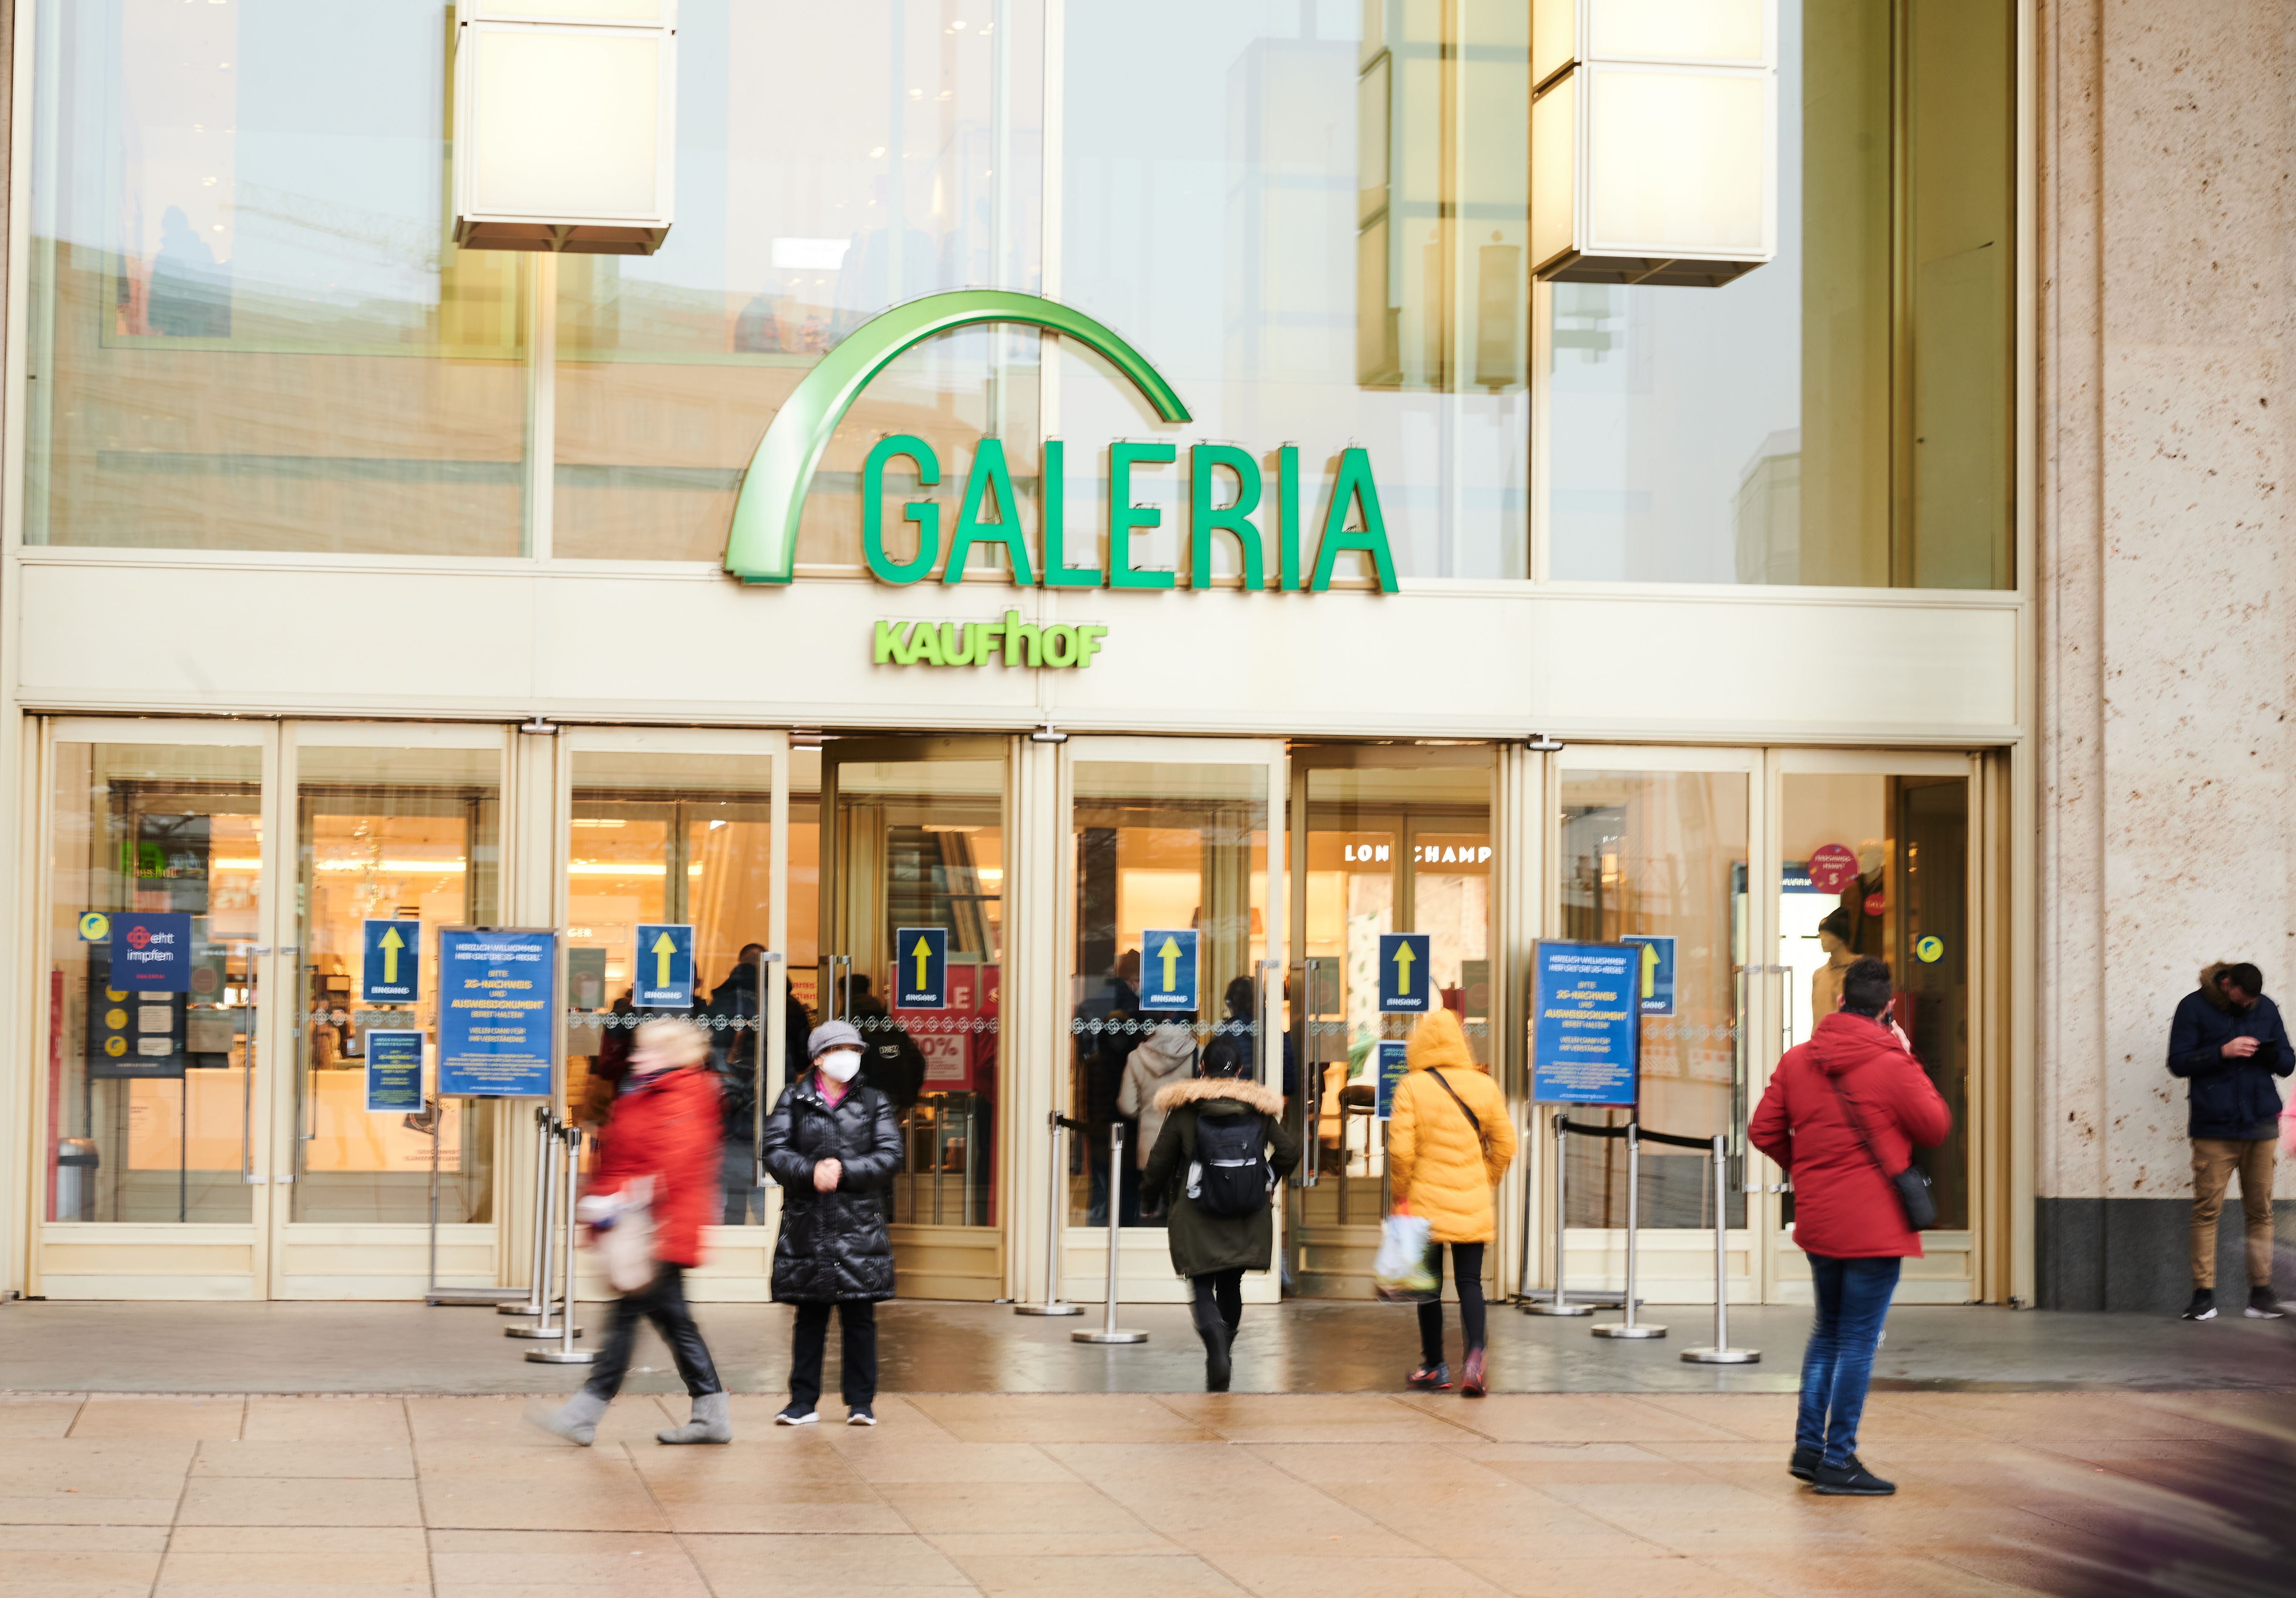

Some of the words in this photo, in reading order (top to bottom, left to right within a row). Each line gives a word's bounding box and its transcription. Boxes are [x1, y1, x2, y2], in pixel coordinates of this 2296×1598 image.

[863, 434, 1399, 594] GALERIA
[127, 948, 173, 963] impfen
[371, 986, 410, 995] EINGANG
[644, 990, 682, 999] EINGANG
[1150, 994, 1188, 1003] EINGANG
[1387, 998, 1422, 1006] EINGANG
[1641, 1001, 1666, 1009] GANG
